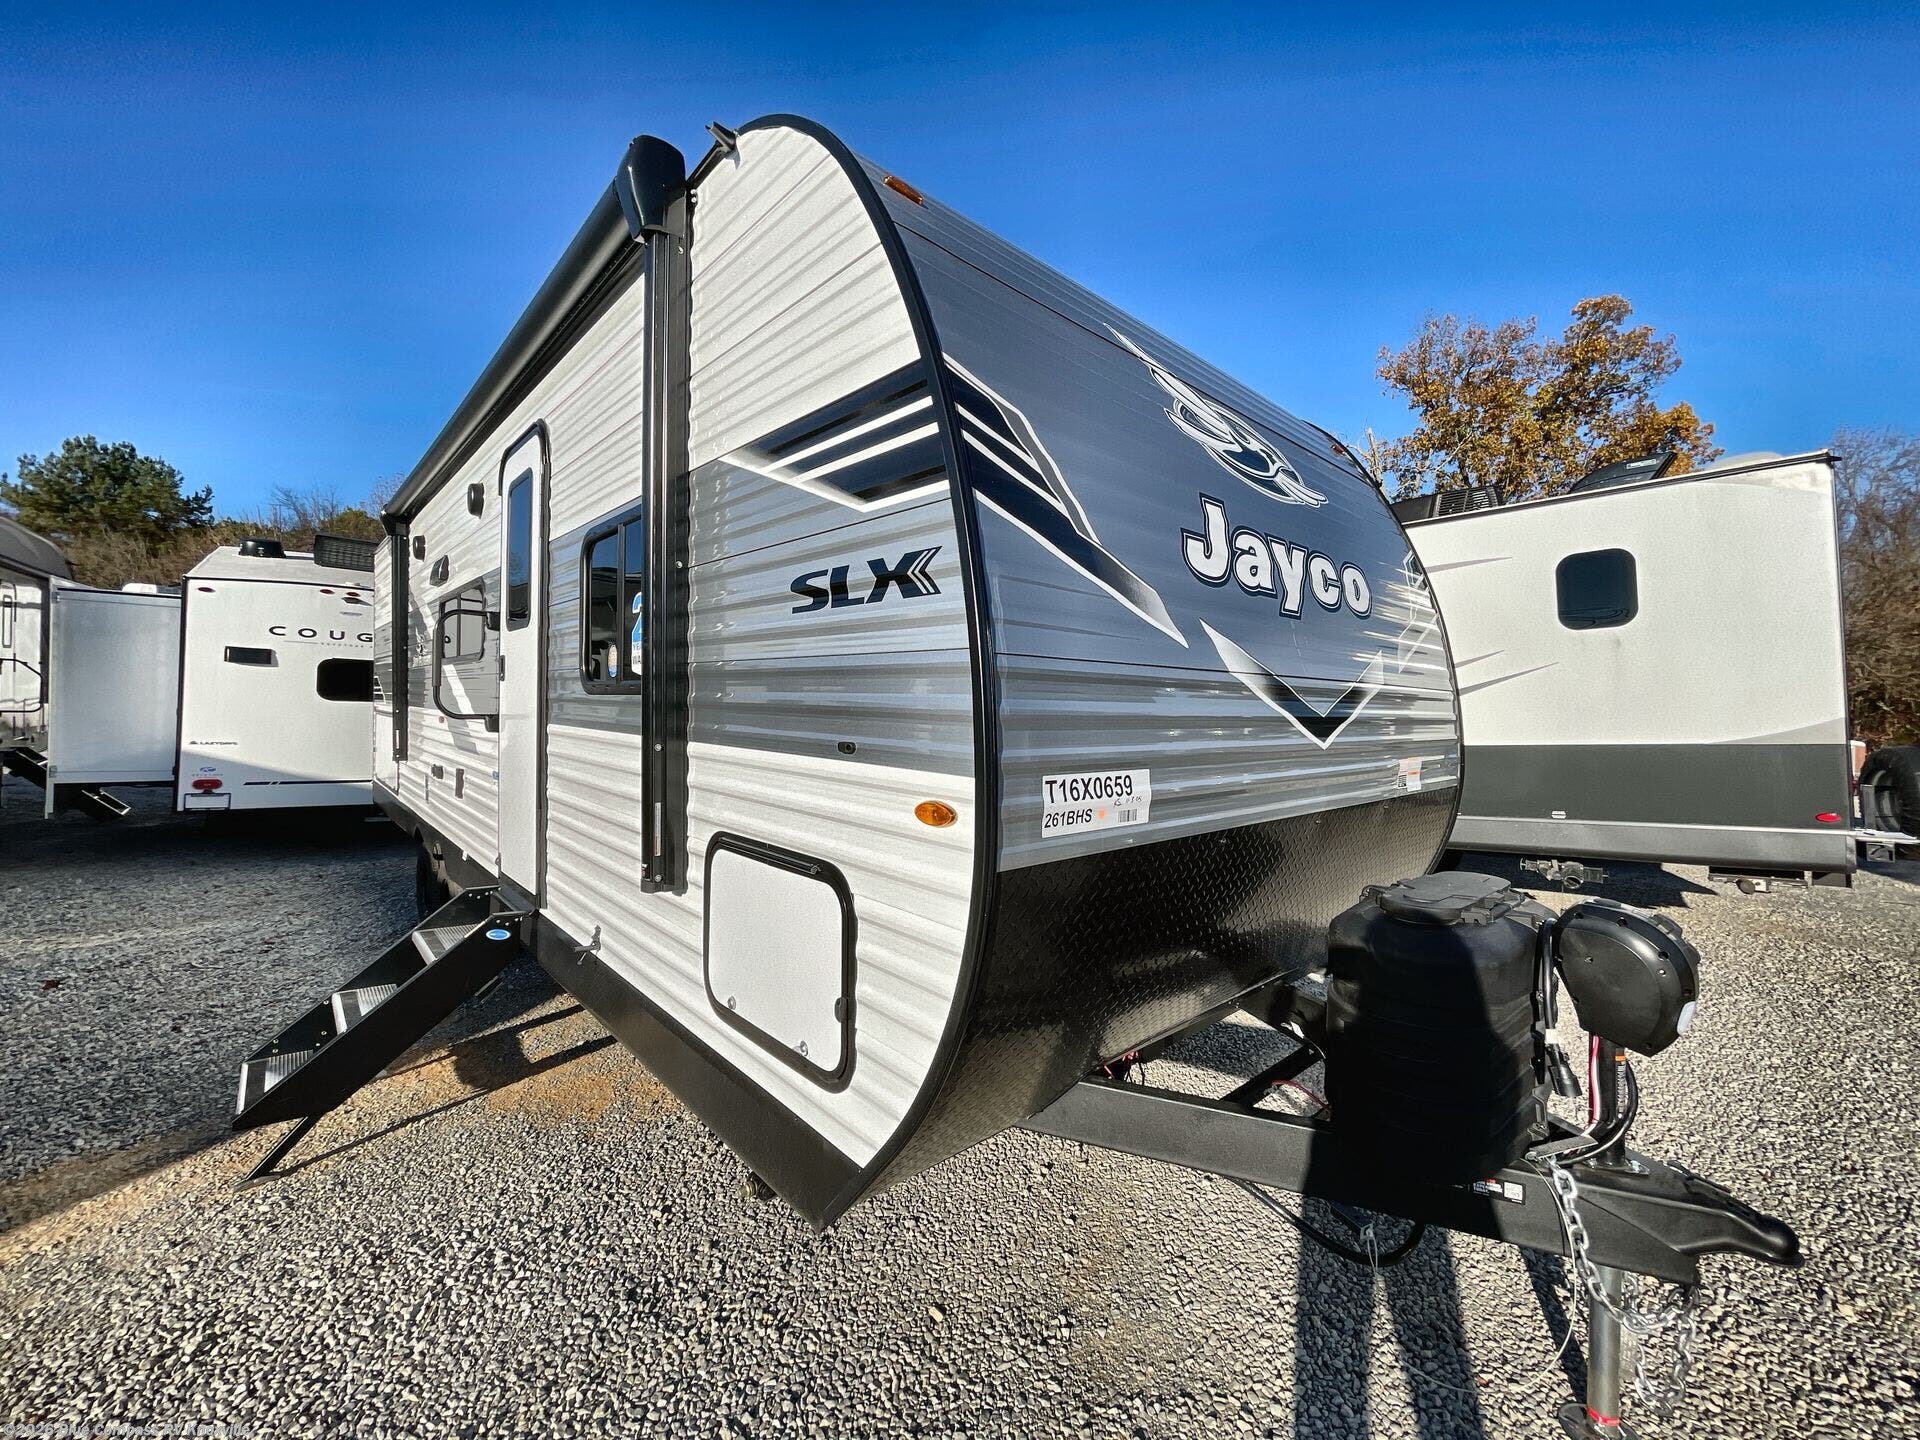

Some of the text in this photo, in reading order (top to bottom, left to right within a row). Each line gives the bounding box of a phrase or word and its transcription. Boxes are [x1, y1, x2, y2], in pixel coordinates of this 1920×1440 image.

[790, 545, 943, 614] SLX
[1179, 492, 1373, 620] Jayco
[1045, 774, 1133, 804] T16X0659
[1044, 808, 1093, 829] 261BHS
